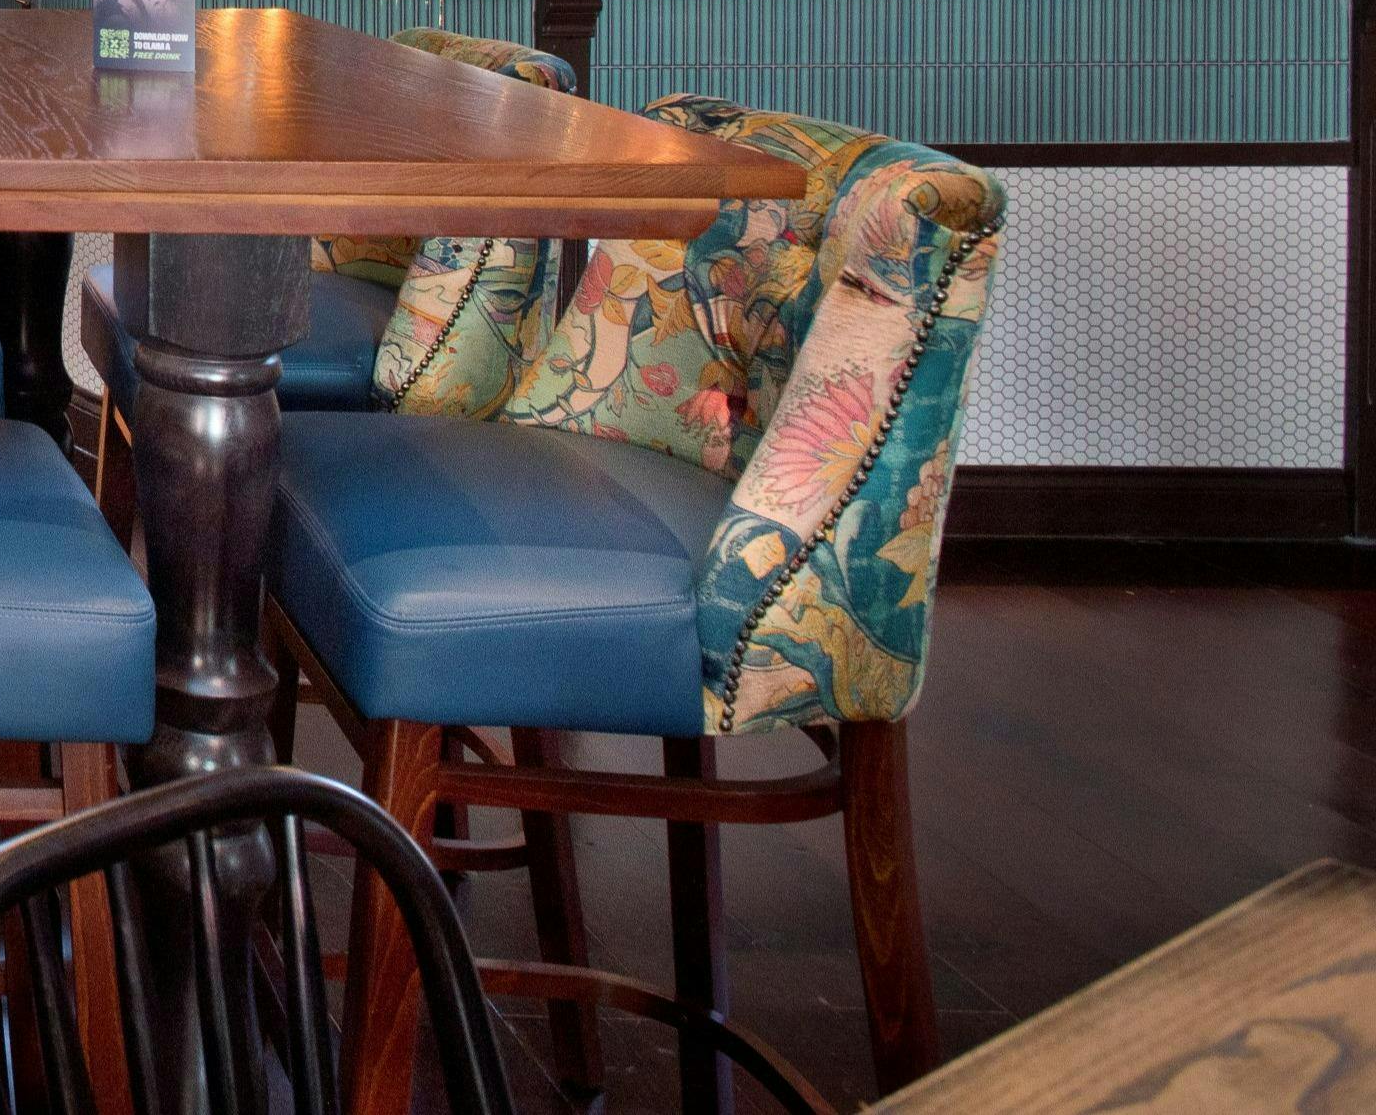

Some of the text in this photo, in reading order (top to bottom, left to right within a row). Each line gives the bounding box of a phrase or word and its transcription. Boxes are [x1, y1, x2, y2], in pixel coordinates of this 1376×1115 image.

[133, 32, 188, 42] DOWNLOAD NOW
[133, 41, 143, 49] TO
[165, 42, 171, 51] A
